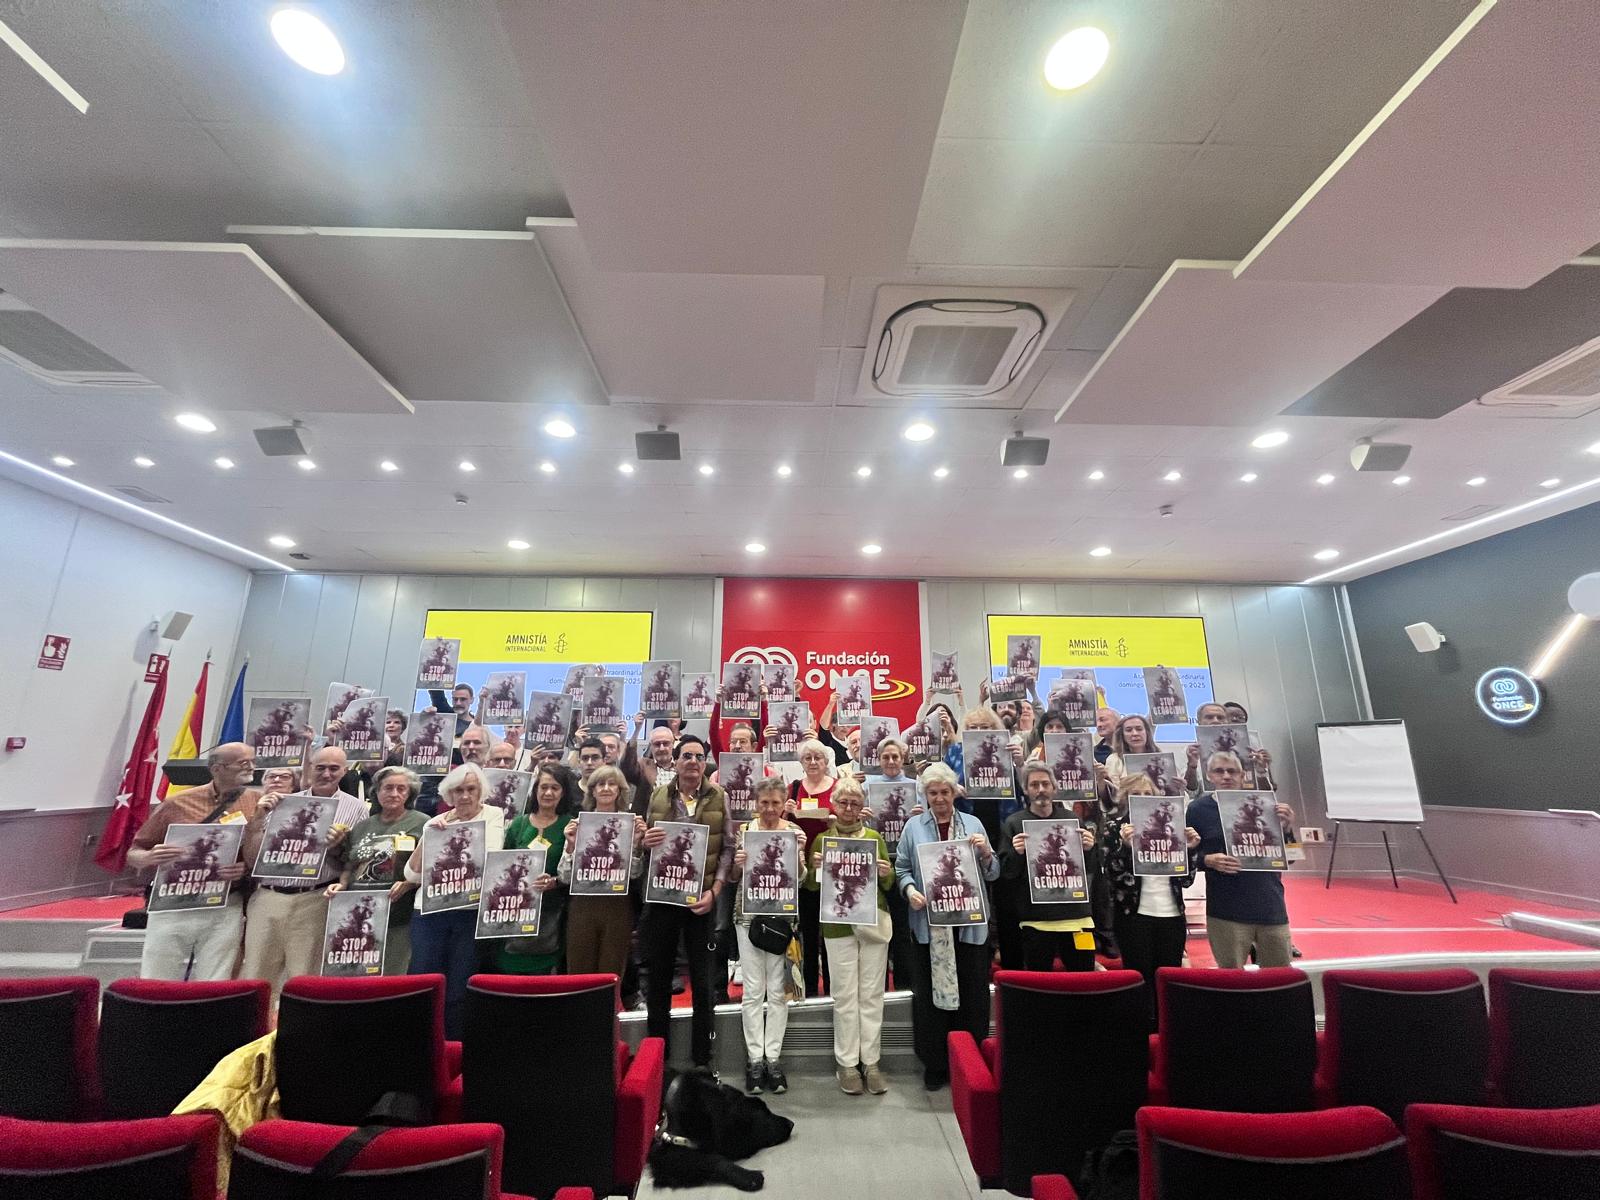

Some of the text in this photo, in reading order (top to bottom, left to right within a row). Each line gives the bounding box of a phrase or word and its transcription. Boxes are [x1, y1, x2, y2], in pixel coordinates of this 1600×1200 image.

[506, 633, 547, 645] AMNISTÍA
[1069, 638, 1108, 649] AMNISTÍA
[806, 652, 890, 665] Fundación
[429, 665, 445, 673] STOP
[805, 669, 890, 690] ONE
[651, 692, 668, 701] STOP
[733, 692, 749, 701] STOP
[1159, 697, 1175, 706] STOP
[594, 707, 611, 715] STOP
[847, 702, 861, 710] STOP
[1065, 702, 1083, 711] STOP
[1493, 701, 1524, 709] ONCE
[538, 724, 556, 732] STOP
[264, 735, 289, 745] STOP
[351, 730, 371, 739] STOP
[781, 734, 798, 743] STOP
[913, 735, 930, 744] STOP
[256, 745, 301, 757] ENOCIDIO
[418, 745, 439, 755] STOP
[909, 744, 939, 755] ENOCIDIO
[407, 755, 449, 765] GENOCIDIO
[979, 767, 998, 777] STOP
[1062, 769, 1082, 779] STOP
[969, 776, 1011, 788] GENOCIDIO
[1058, 779, 1094, 790] ENOCIDIO
[731, 789, 750, 799] STOP
[885, 820, 904, 831] STOP
[281, 839, 308, 851] STOP
[1150, 839, 1172, 851] STOP
[1242, 833, 1265, 845] STOP
[1138, 850, 1185, 863] GENOCIDIO
[1232, 844, 1282, 857] GENOCIDIO
[263, 850, 320, 865] GENOCIDIO
[590, 856, 614, 868] STOP
[826, 850, 873, 864] GENOCIDIO
[179, 869, 211, 882] STOP
[442, 867, 467, 882] STOP
[576, 867, 626, 881] GENOCIDIO
[666, 865, 688, 878] STOP
[838, 864, 861, 877] STOP
[1045, 863, 1068, 876] STOP
[427, 877, 482, 898] GENOCIDIO
[652, 877, 699, 893] GENOCIDIO
[759, 875, 781, 888] STOP
[1034, 875, 1083, 889] GENOCIDIO
[159, 881, 226, 897] GENOCIDIO
[747, 887, 794, 900] GENOCIDIO
[941, 885, 964, 899] STOP
[498, 895, 523, 909] STOP
[931, 897, 980, 912] GENOCIDIO
[483, 908, 536, 923] GENOCIDIO
[342, 938, 367, 951] STOP
[328, 950, 380, 964] GENOCIDIO
